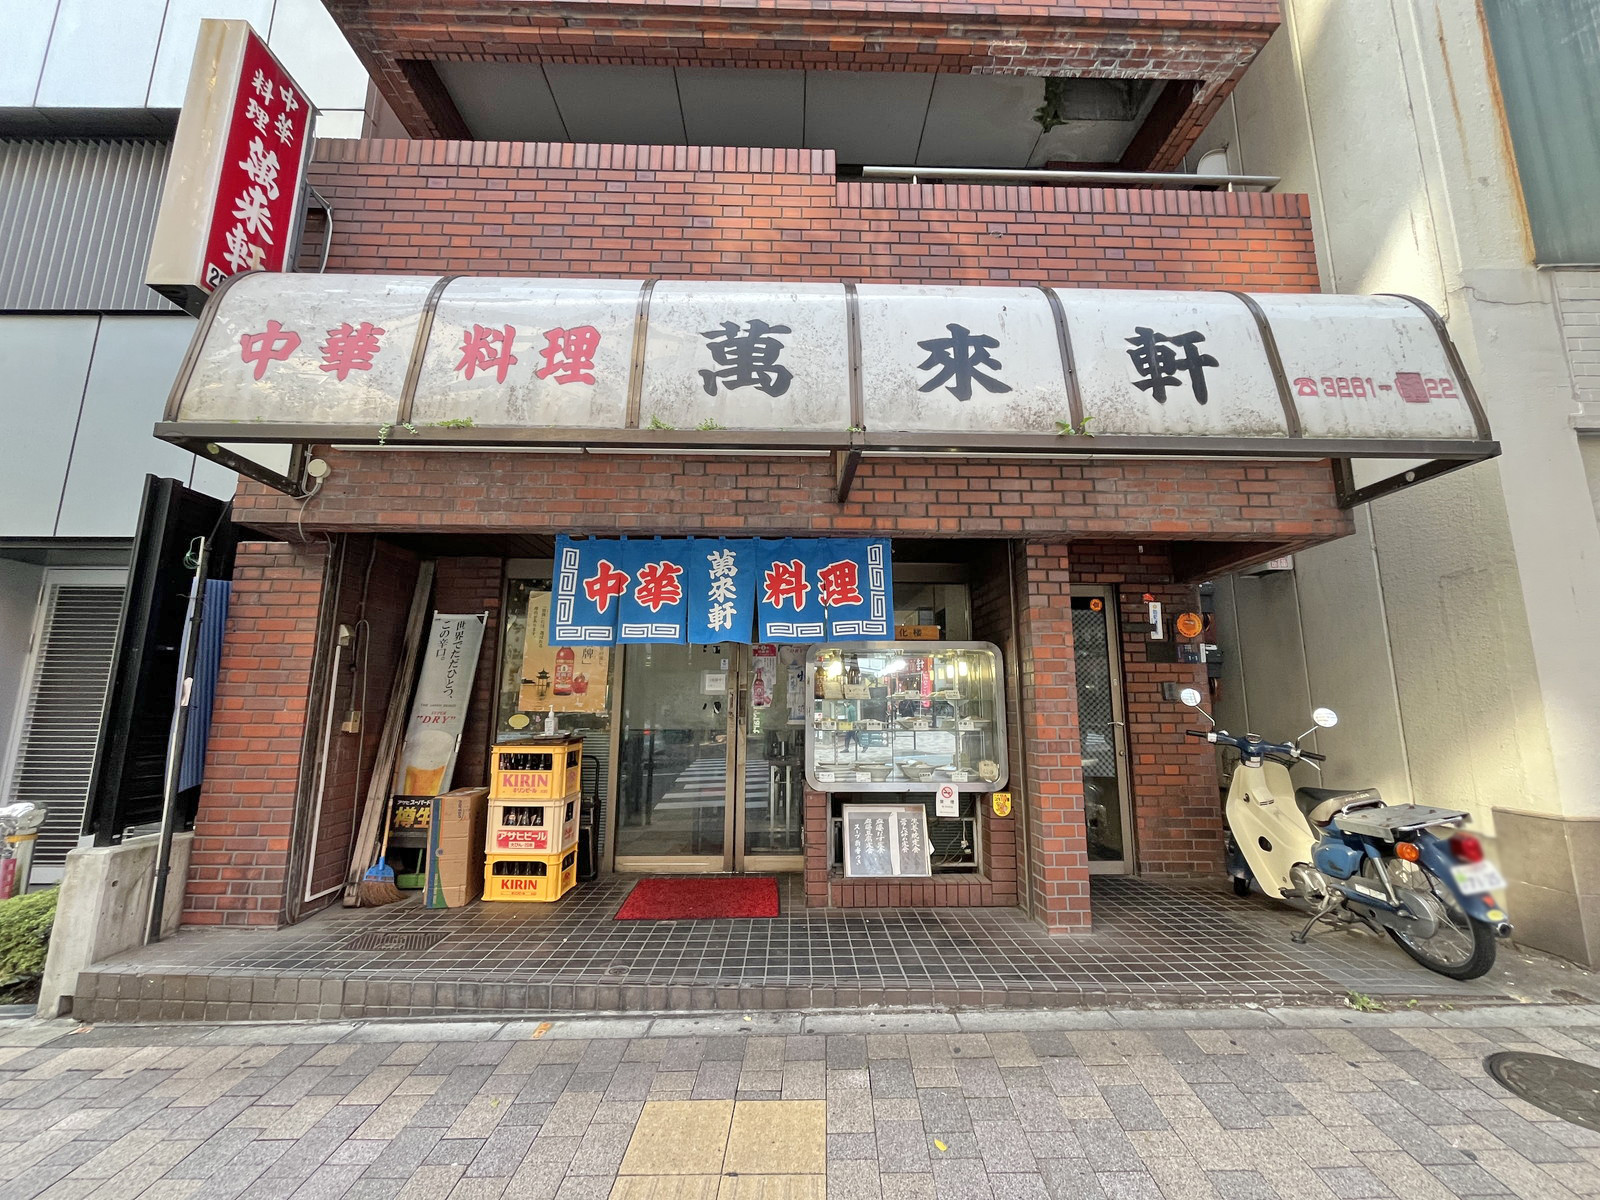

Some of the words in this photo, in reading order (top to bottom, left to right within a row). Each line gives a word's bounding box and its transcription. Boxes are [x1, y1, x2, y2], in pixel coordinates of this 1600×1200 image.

[245, 68, 275, 138] 料理
[275, 85, 299, 148] 中華
[1320, 375, 1459, 402] 3281-22
[583, 559, 682, 614] 中華
[762, 559, 863, 612] 料理
[503, 774, 548, 787] KIRIN
[498, 831, 547, 841] アサヒビール
[501, 879, 538, 890] KIRIN
